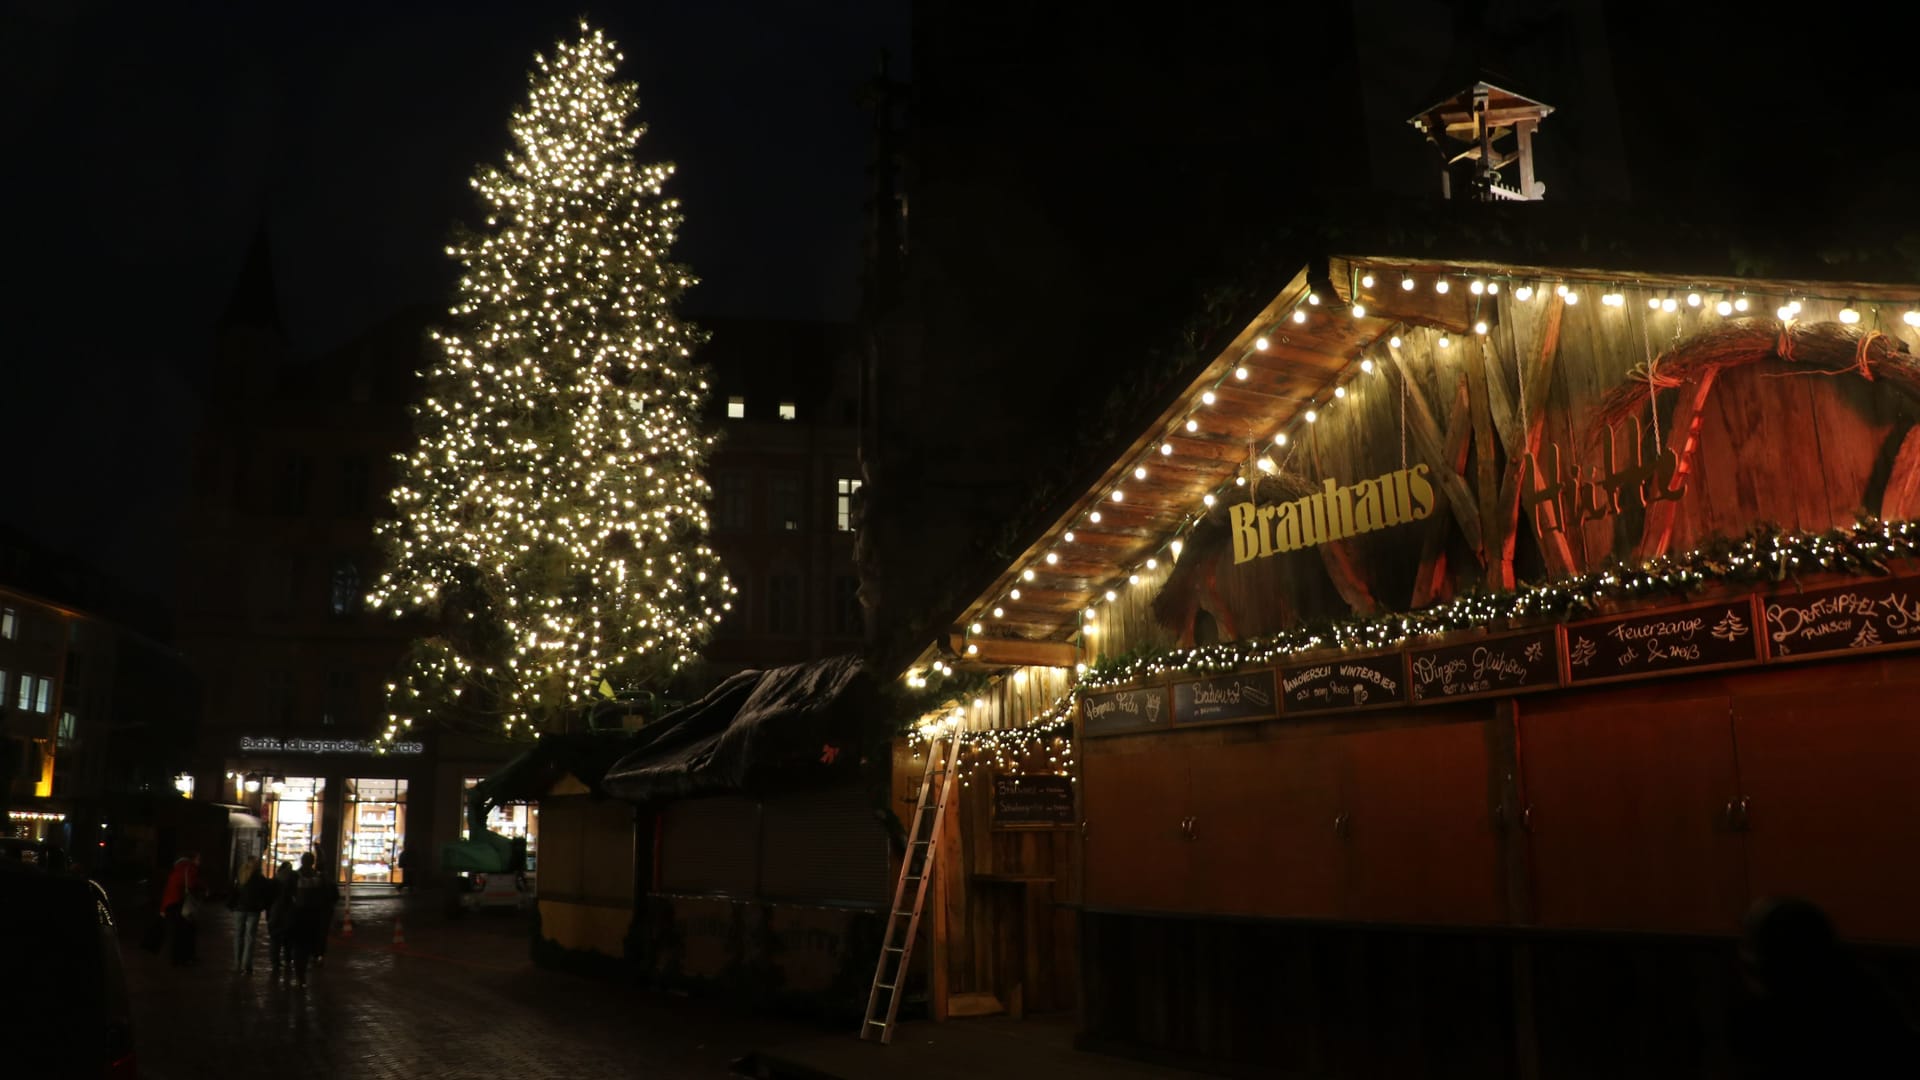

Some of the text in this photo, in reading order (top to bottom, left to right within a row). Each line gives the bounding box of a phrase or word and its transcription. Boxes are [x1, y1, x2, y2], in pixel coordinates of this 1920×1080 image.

[1230, 463, 1436, 565] Brauhaus
[1608, 617, 1704, 641] Feuerzange
[1801, 619, 1852, 640] PUNSCH
[1617, 646, 1639, 667] rot
[1647, 638, 1668, 663] &
[1340, 664, 1397, 696] WINTERBIER
